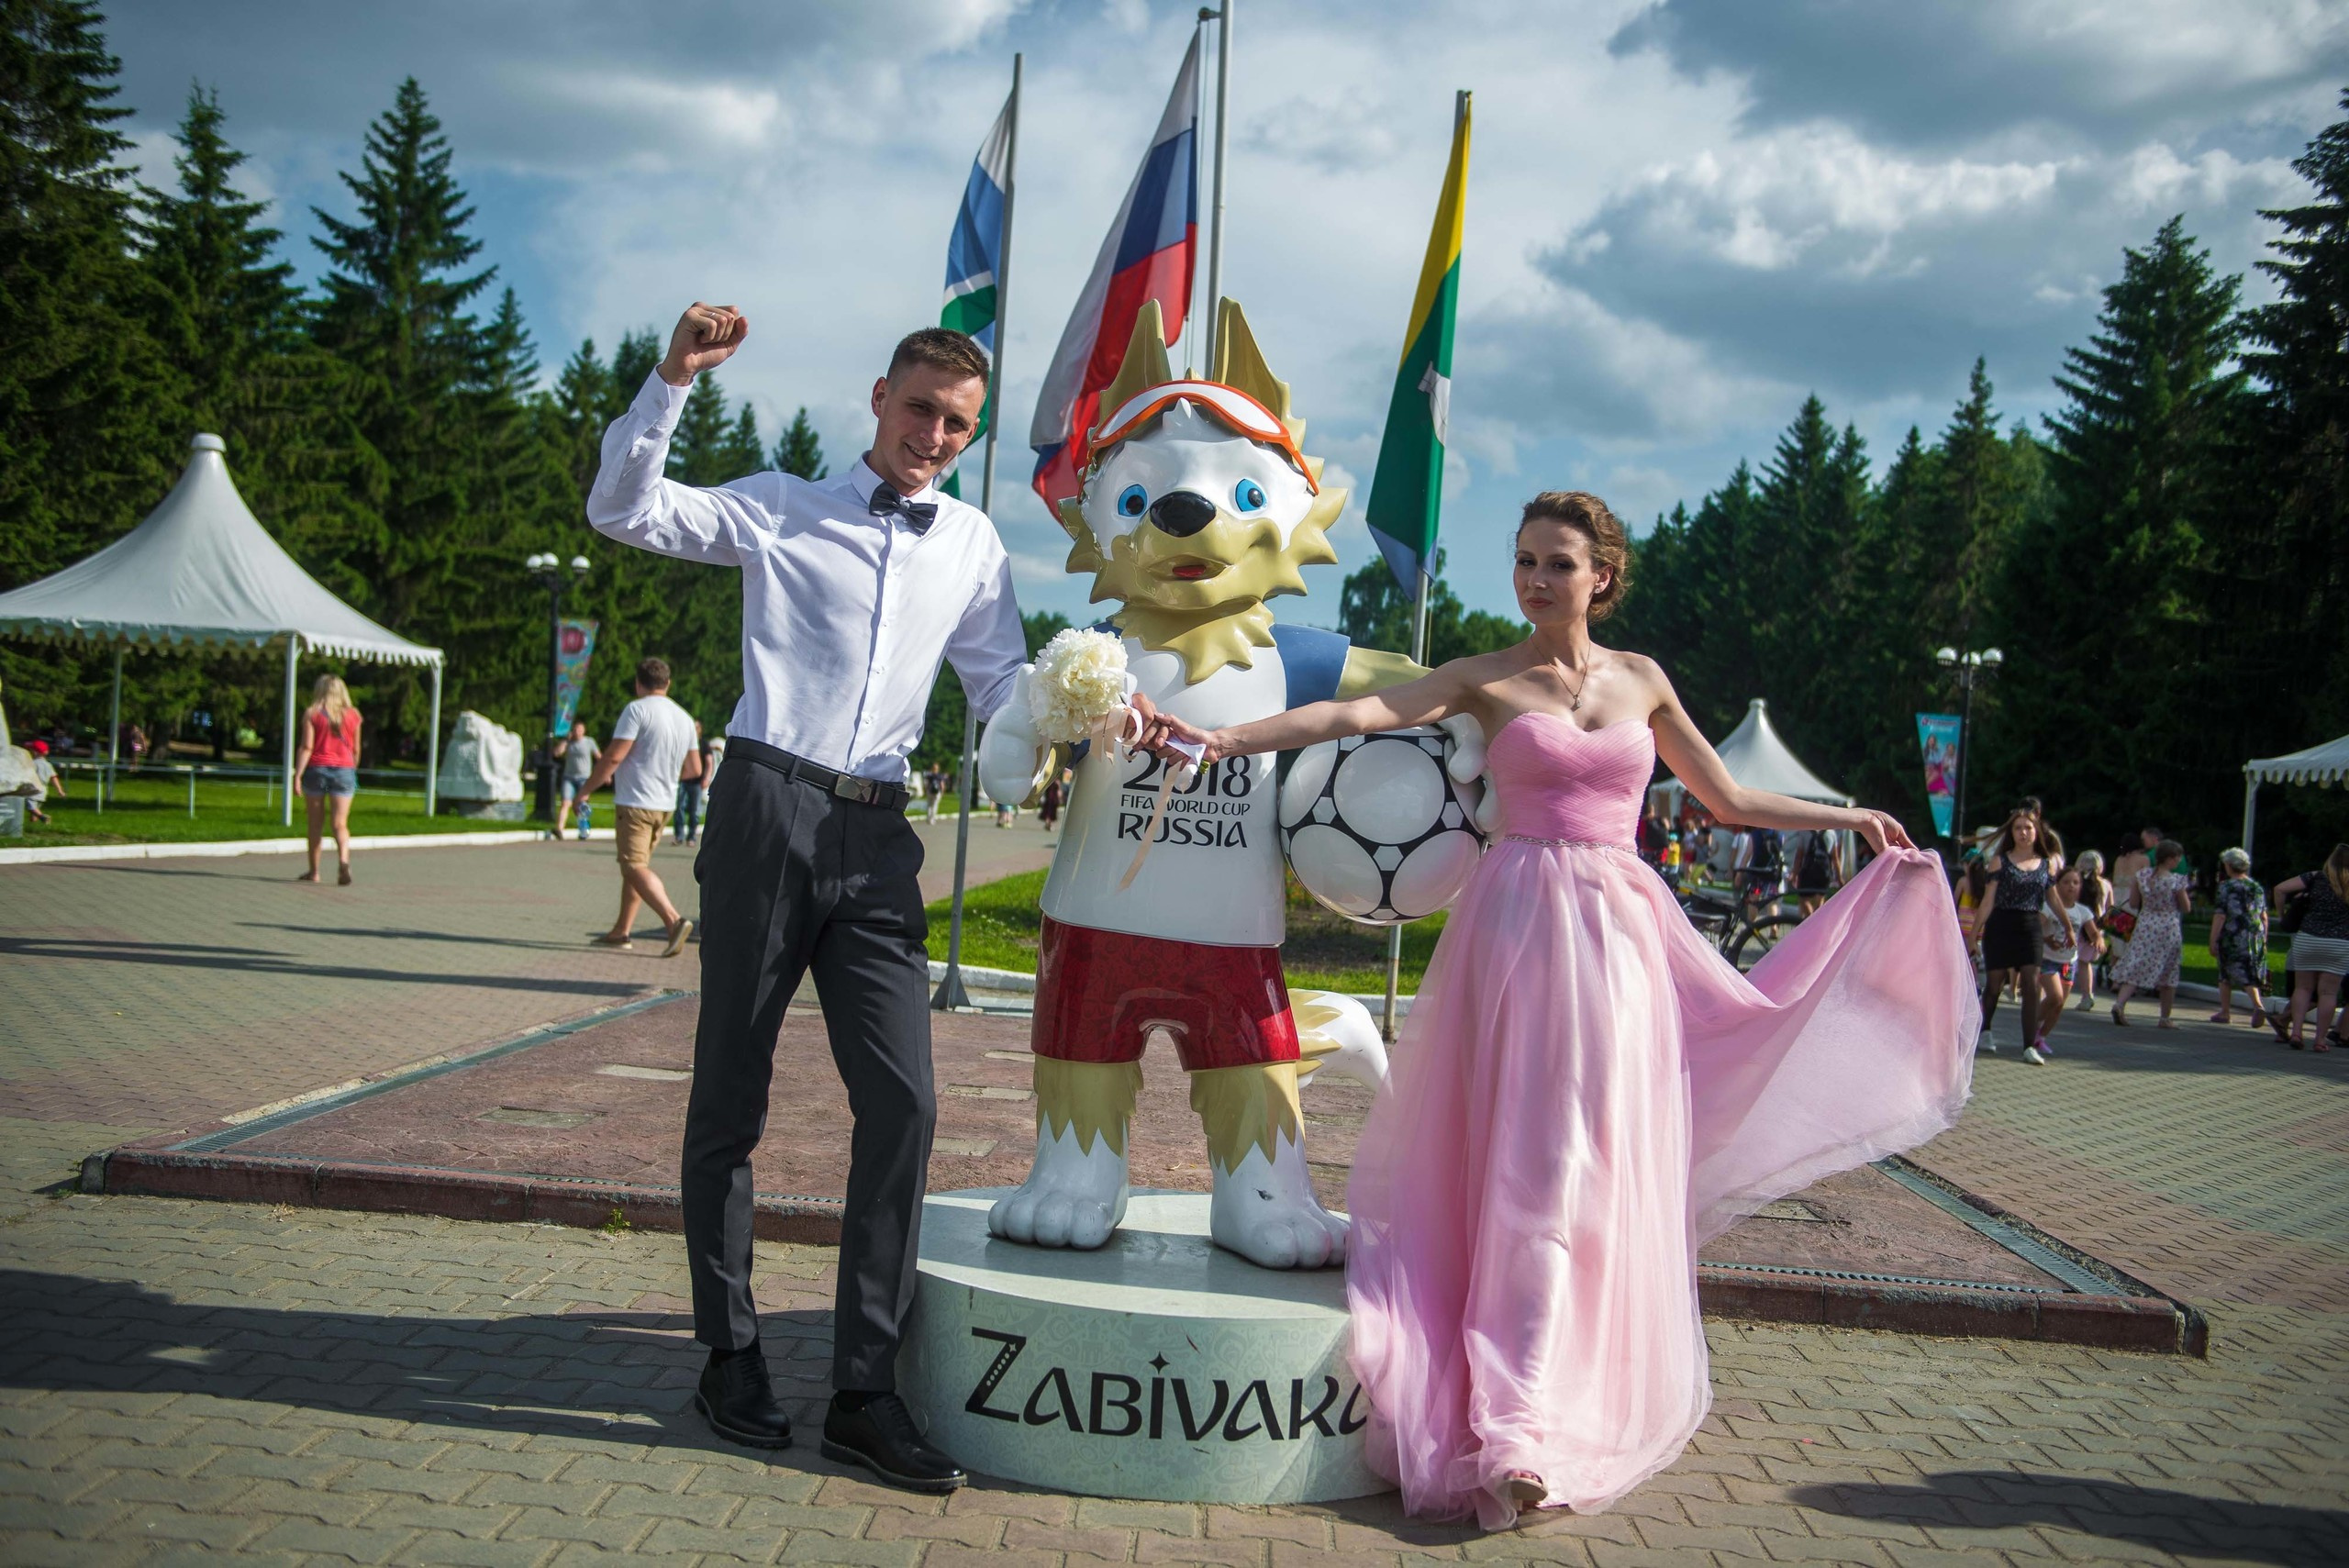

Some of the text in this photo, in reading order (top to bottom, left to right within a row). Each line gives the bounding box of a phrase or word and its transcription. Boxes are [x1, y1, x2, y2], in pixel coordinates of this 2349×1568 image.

[1120, 794, 1155, 810] FIFA
[1221, 802, 1251, 817] CUP
[1118, 812, 1248, 849] RUSSIA
